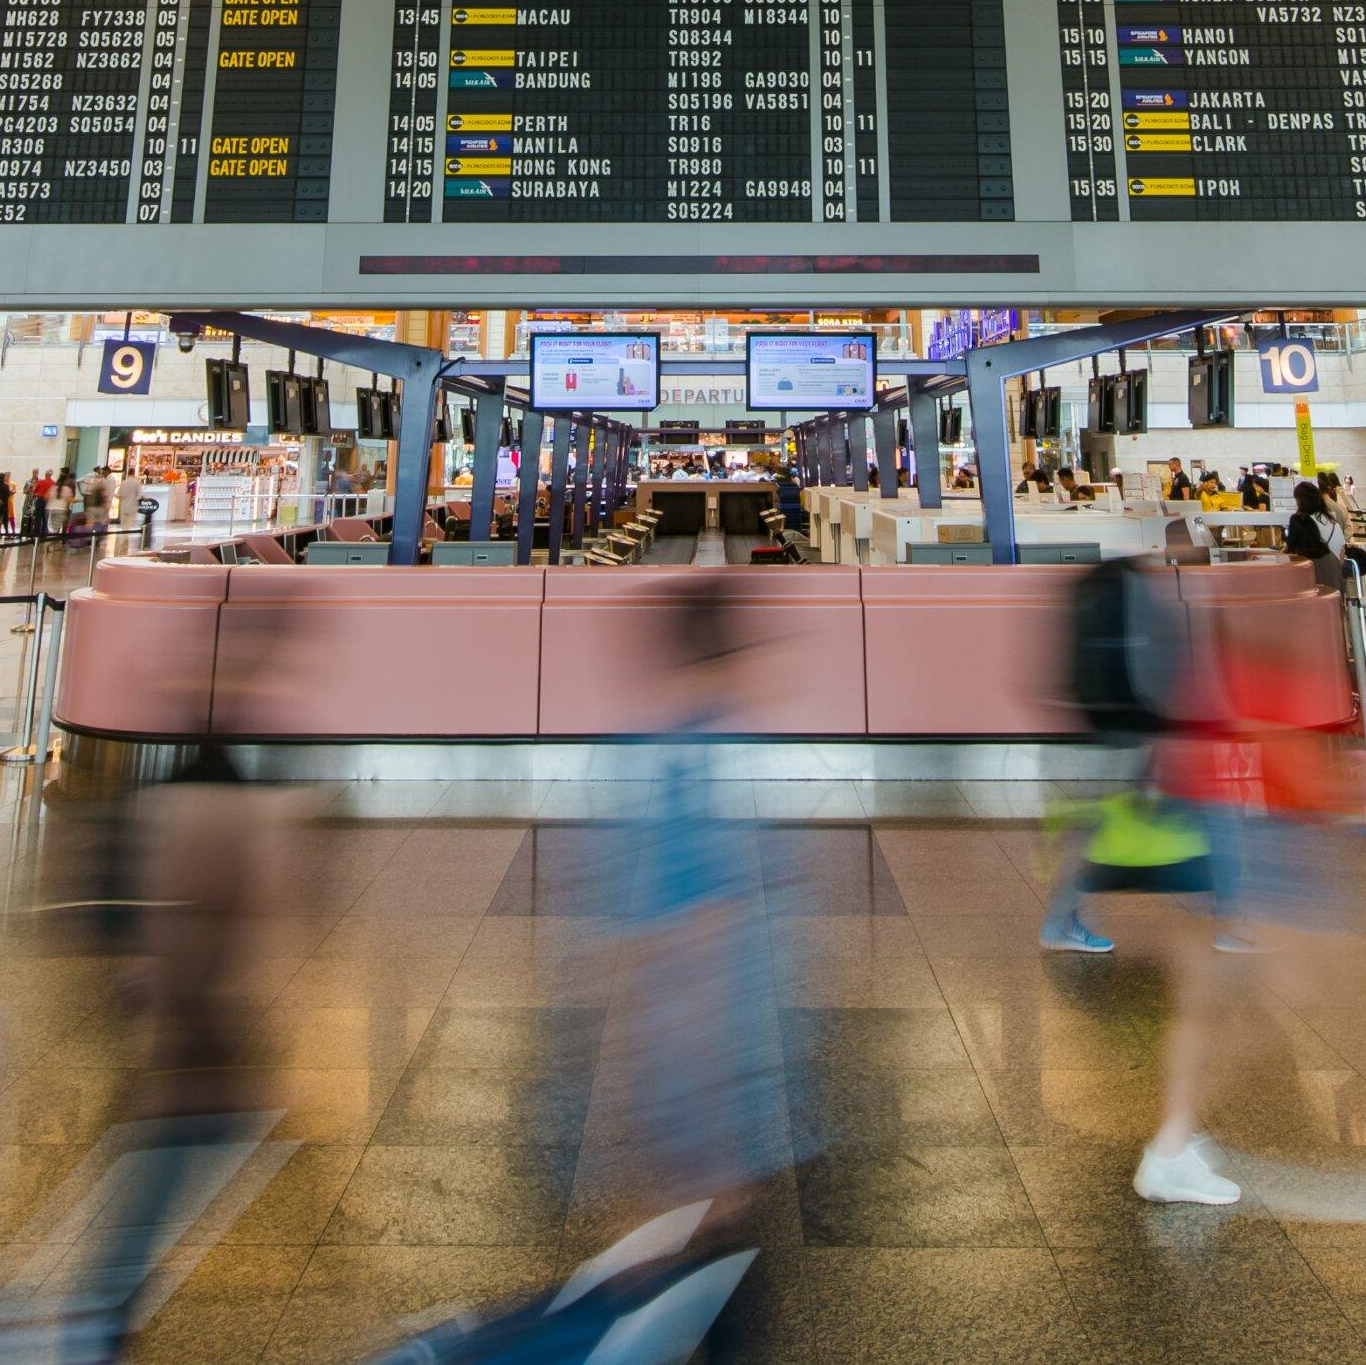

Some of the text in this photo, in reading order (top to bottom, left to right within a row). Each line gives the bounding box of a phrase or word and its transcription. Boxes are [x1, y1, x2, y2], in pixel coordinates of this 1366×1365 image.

[517, 10, 570, 25] MACAU
[1183, 29, 1235, 44] HANOI
[517, 52, 579, 67] TAIPEI
[1185, 50, 1250, 65] YANGON
[515, 73, 591, 88] BANDUNG
[1189, 92, 1264, 107] JAKARTA
[514, 116, 567, 132] PERTH
[1191, 114, 1334, 129] BALI DENPAS
[513, 138, 578, 153] MANILA
[1193, 136, 1247, 152] CLARK
[513, 160, 612, 175] HONG KONG
[512, 182, 599, 197] SURABAYA
[1199, 181, 1239, 196] IPOH
[110, 346, 143, 389] 9
[1260, 345, 1315, 386] 10
[660, 389, 744, 402] DEPARTU
[170, 433, 243, 443] CANDIES
[1300, 423, 1311, 466] Bag-Drop
